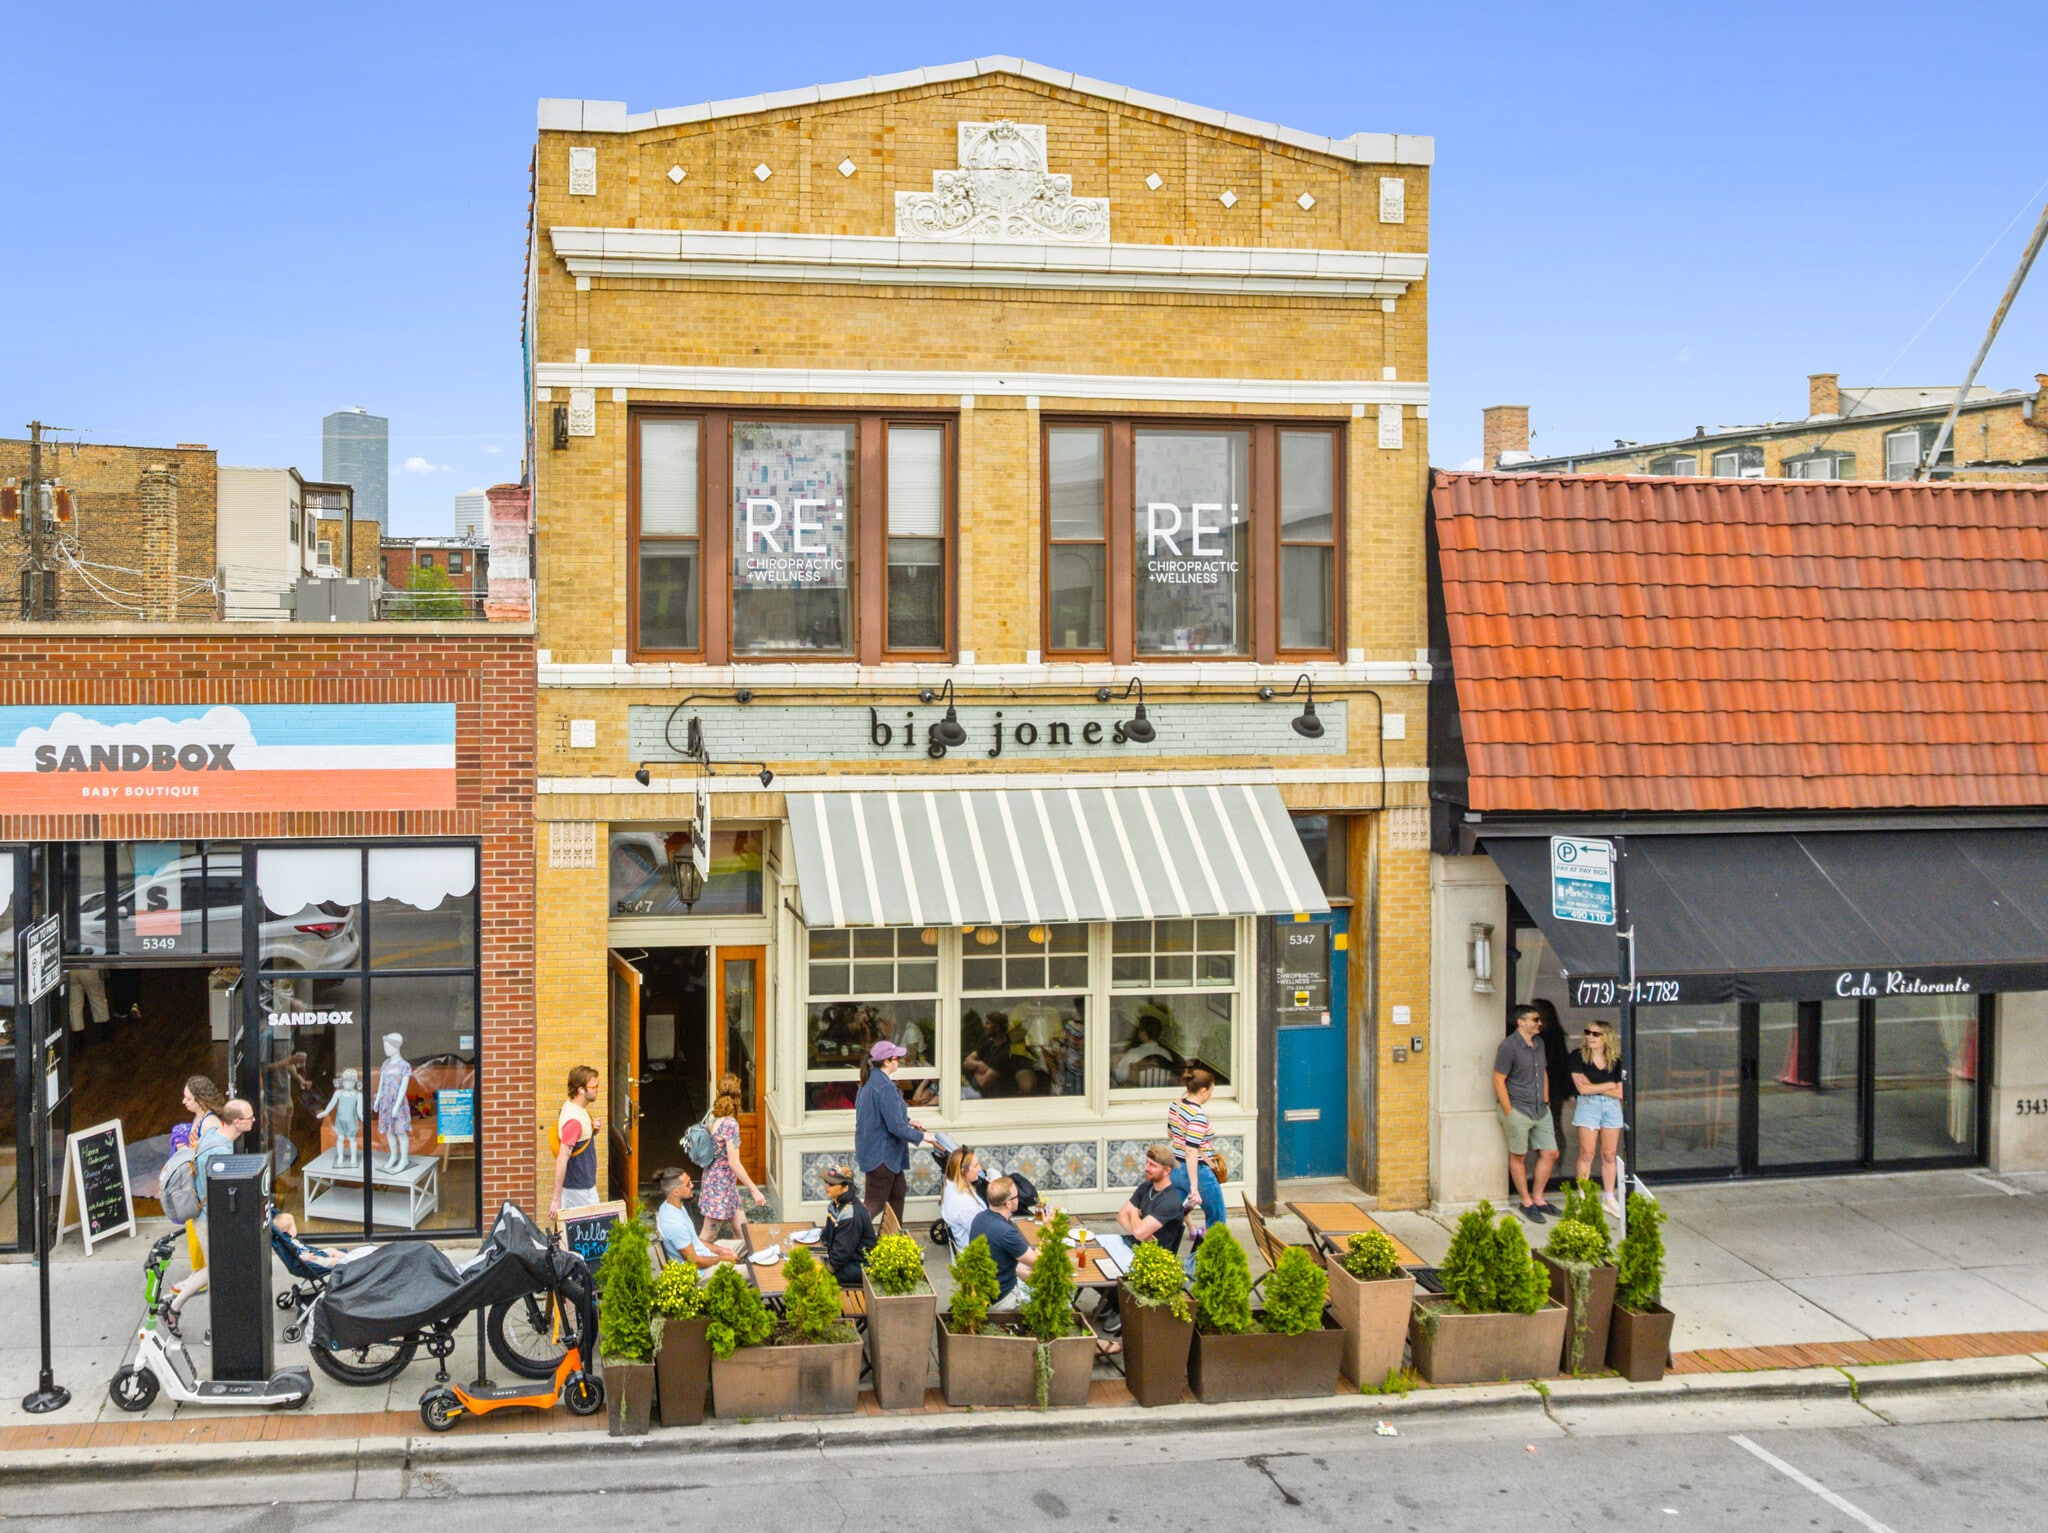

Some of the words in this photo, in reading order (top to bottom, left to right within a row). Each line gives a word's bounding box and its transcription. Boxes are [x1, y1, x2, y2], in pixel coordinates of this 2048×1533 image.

[746, 498, 843, 553] RE:
[1147, 503, 1239, 556] RE:
[747, 559, 843, 570] CHIROPRACTIC
[1148, 561, 1239, 572] CHIROPRACTIC
[747, 570, 821, 582] +WELLNESS
[1148, 572, 1218, 584] +WELLNESS
[988, 711, 1130, 758] jones
[35, 743, 236, 773] SANDBOX
[82, 786, 119, 797] BABY
[125, 786, 200, 797] BOUTIQUE
[146, 886, 169, 913] S
[617, 900, 654, 913] 5347
[1590, 913, 1607, 922] 110
[142, 938, 176, 950] 5349
[1289, 934, 1315, 945] 5347
[1836, 972, 1878, 997] Calo
[1886, 970, 1972, 994] Ristorante
[1577, 980, 1615, 1005] (773)
[268, 1011, 354, 1026] SANDBOX
[2016, 1098, 2048, 1116] 5343
[575, 1222, 609, 1241] hello
